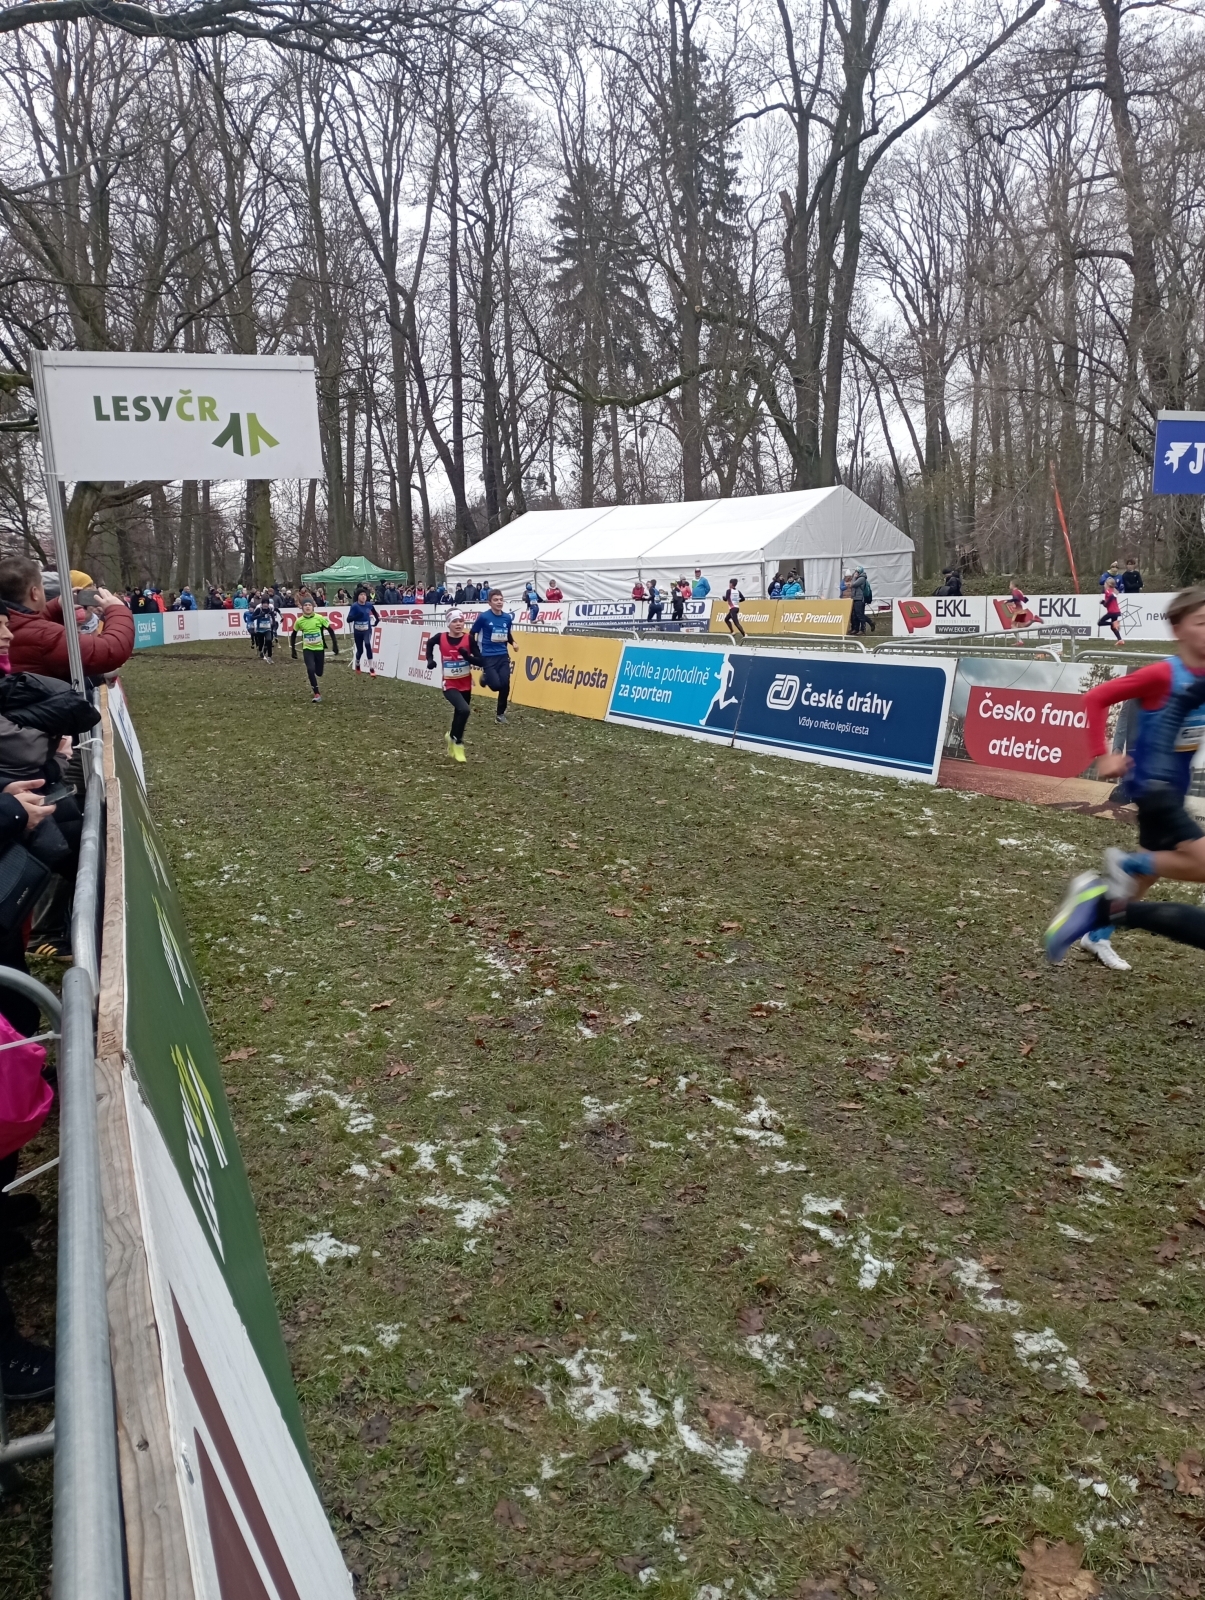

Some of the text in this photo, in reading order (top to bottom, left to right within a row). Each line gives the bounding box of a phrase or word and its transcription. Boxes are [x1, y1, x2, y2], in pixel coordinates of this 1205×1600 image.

[589, 603, 634, 615] JIPAST
[738, 611, 769, 622] Premium
[804, 611, 843, 623] Premium
[935, 599, 971, 617] EKKL
[1039, 598, 1081, 617] EKKL
[544, 658, 576, 685] Česká
[574, 667, 609, 689] pošta
[623, 660, 710, 686] Rychle a pohodlně
[618, 683, 672, 704] za sportem
[801, 682, 893, 720] České dráhy
[979, 691, 1090, 729] Česko fand
[798, 716, 869, 736] Vždy o něco lepší cesta
[988, 735, 1062, 764] atletice
